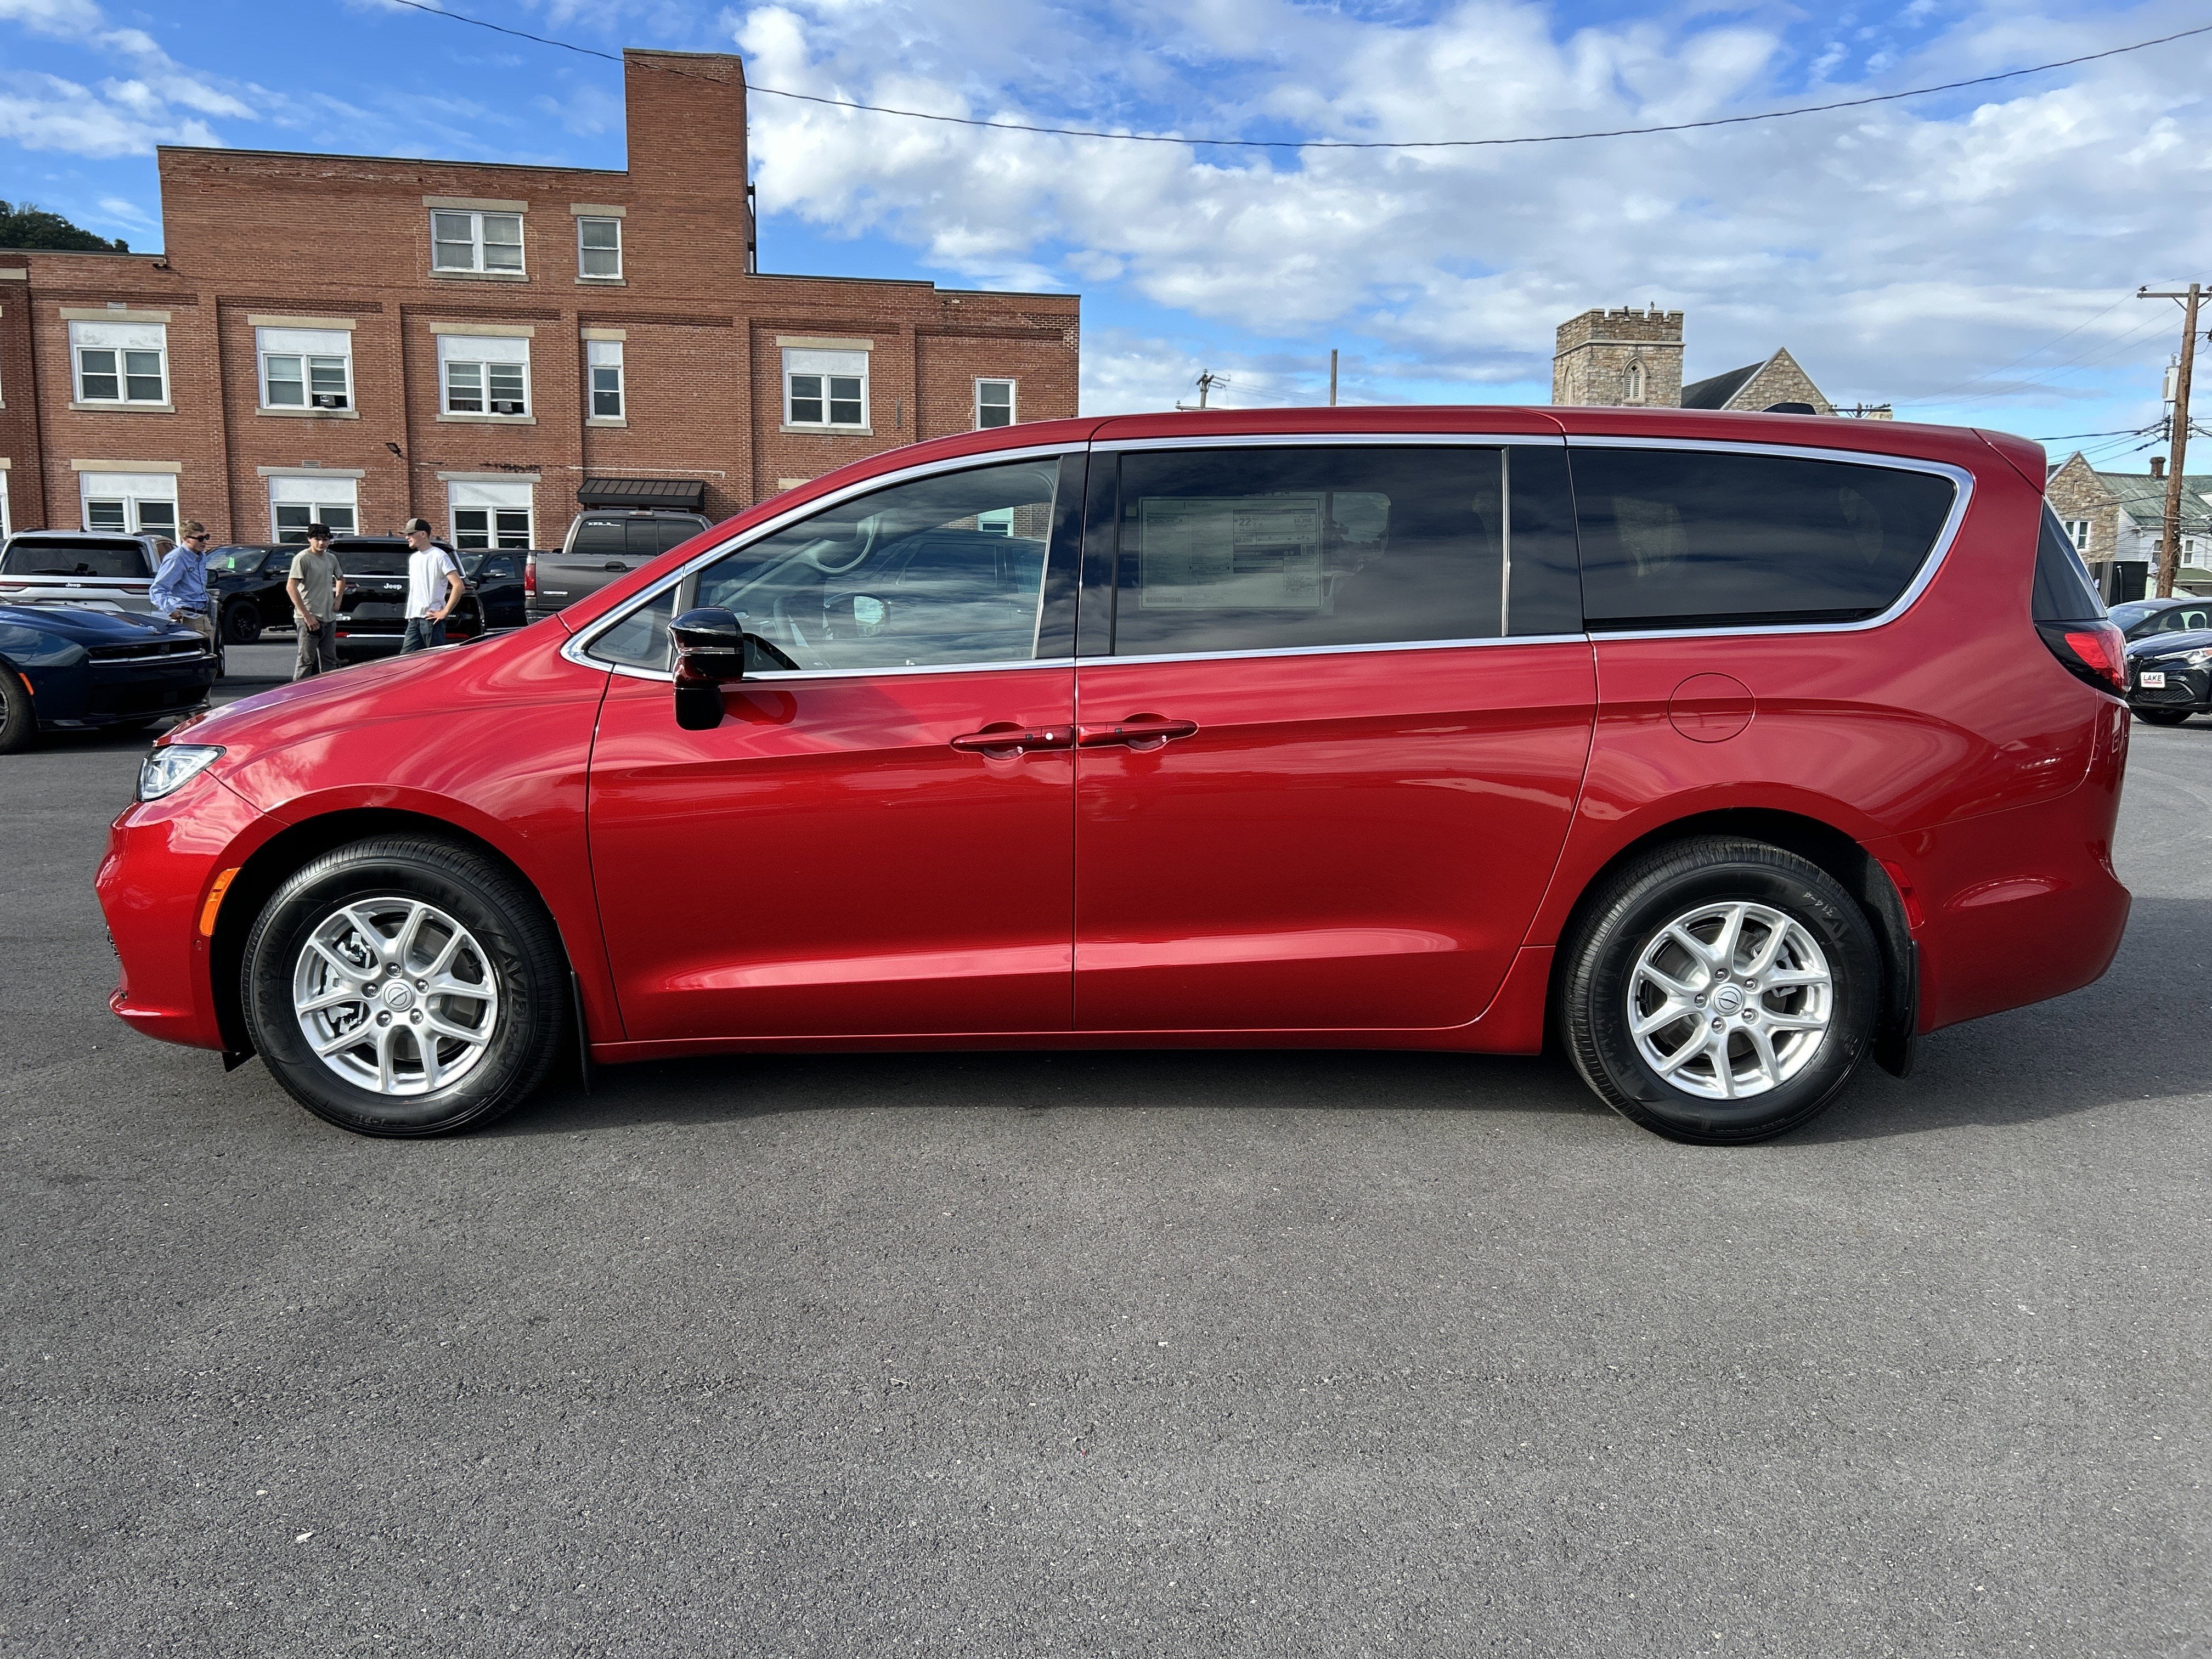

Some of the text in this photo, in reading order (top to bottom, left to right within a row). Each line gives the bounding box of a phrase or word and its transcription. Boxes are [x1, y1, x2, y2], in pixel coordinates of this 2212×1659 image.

[1239, 517, 1251, 526] 22
[258, 927, 288, 1009] YOKOHAMA
[497, 948, 527, 1019] AVID
